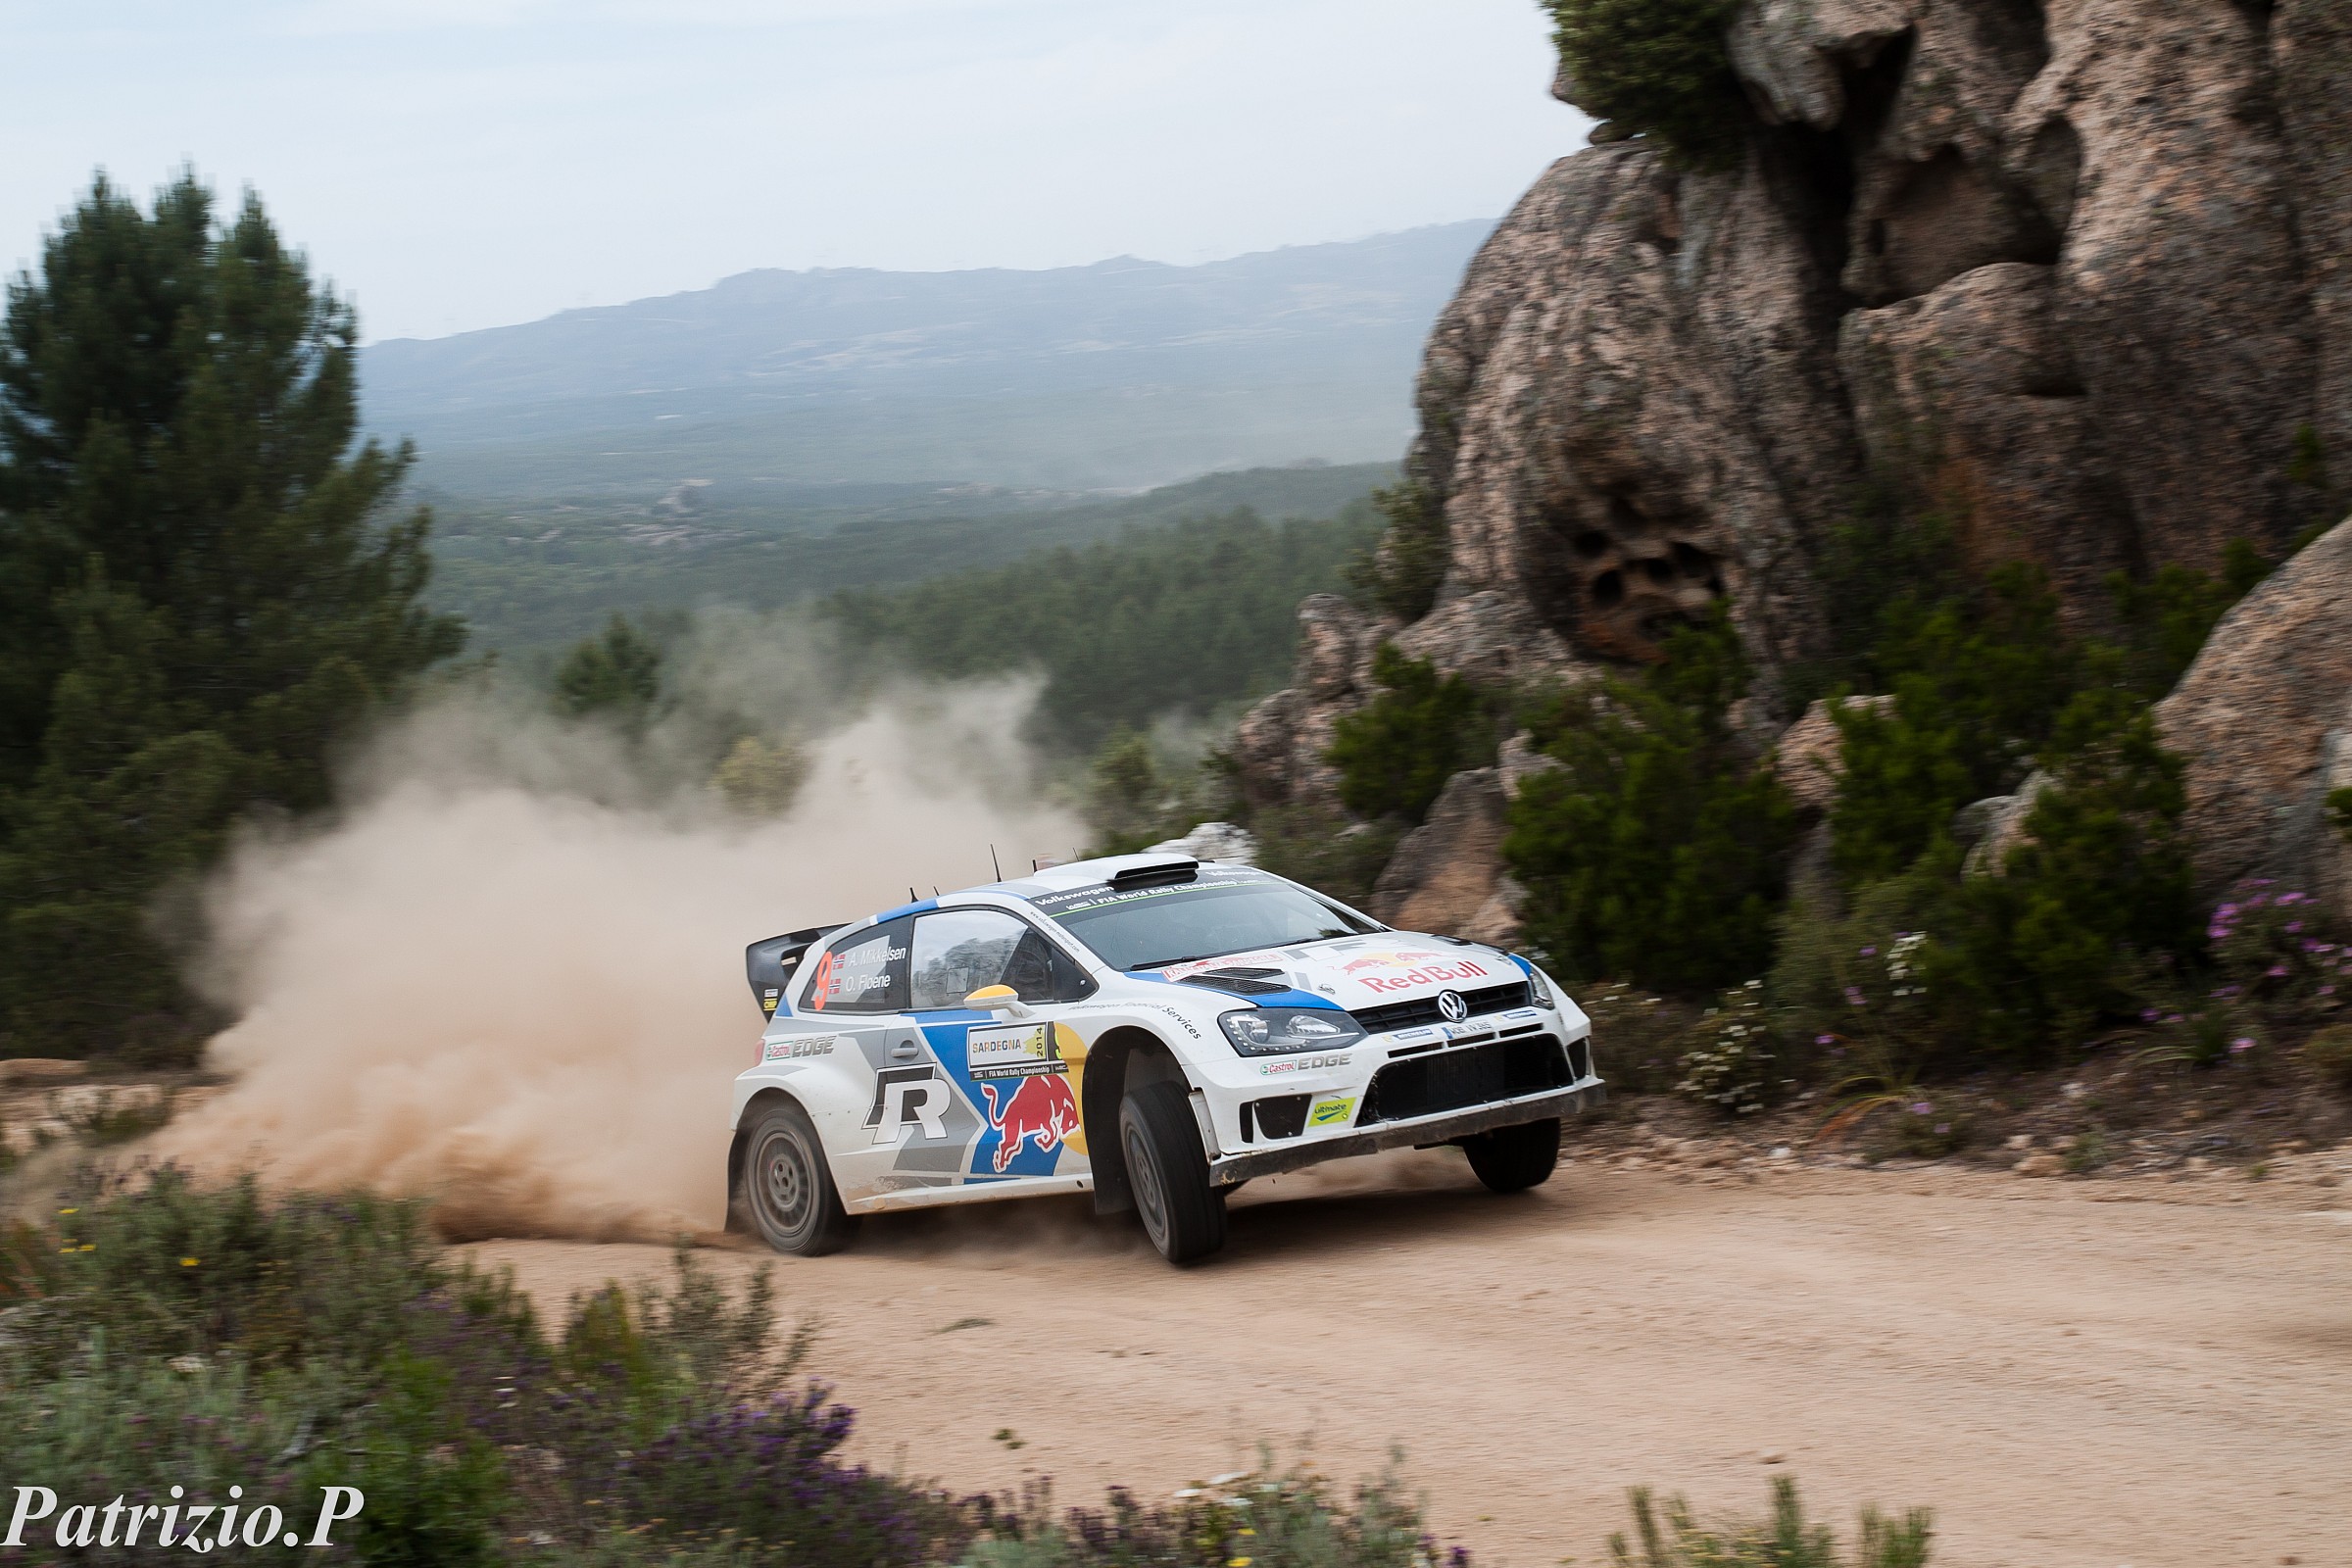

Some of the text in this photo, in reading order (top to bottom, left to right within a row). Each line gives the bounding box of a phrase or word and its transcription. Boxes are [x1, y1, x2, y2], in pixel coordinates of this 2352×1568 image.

[1035, 885, 1114, 906] Volkswagen
[1098, 896, 1117, 905] FIA
[1117, 890, 1148, 901] World
[1149, 885, 1174, 896] Rally
[1174, 879, 1237, 893] Championship
[862, 946, 906, 965] Mikkelsen
[814, 951, 832, 1010] 9
[1161, 1005, 1201, 1040] Services
[792, 1035, 837, 1057] EDGE
[972, 1038, 1021, 1054] SARDEGNA
[1009, 1068, 1020, 1077] Rally
[1020, 1066, 1051, 1076] Championship
[1269, 1054, 1352, 1073] Castrol EDGE
[1314, 1102, 1347, 1114] ultimate
